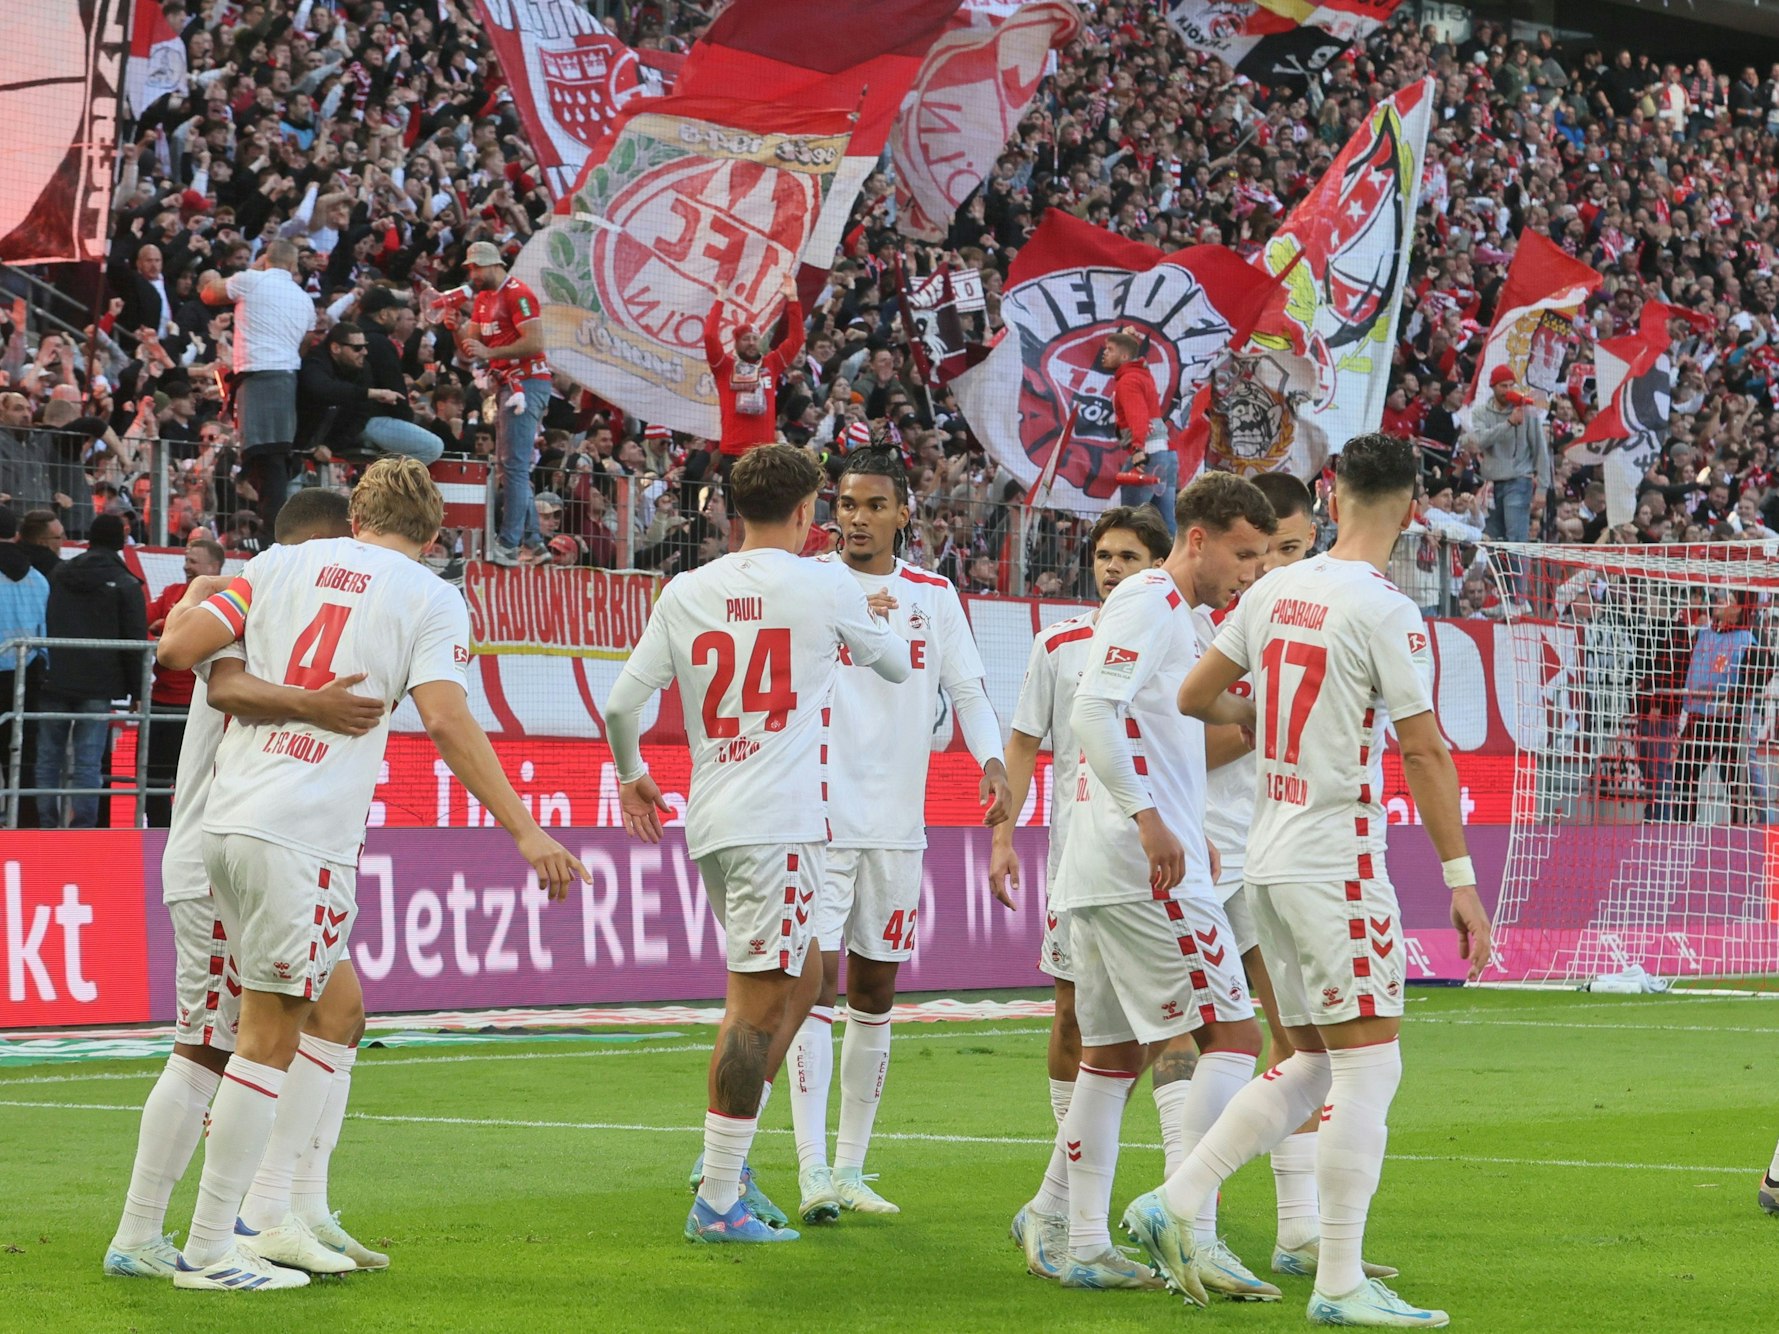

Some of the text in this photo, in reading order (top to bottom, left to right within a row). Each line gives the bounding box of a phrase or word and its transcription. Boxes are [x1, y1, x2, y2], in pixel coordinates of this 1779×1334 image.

[726, 596, 762, 622] PAULI
[1270, 598, 1329, 631] PACARADA
[283, 602, 352, 692] 4
[692, 628, 798, 738] 24
[1261, 638, 1328, 765] 17
[287, 733, 330, 765] KÖLN
[4, 840, 728, 1003] kt Jetzt REW
[882, 909, 917, 950] 42
